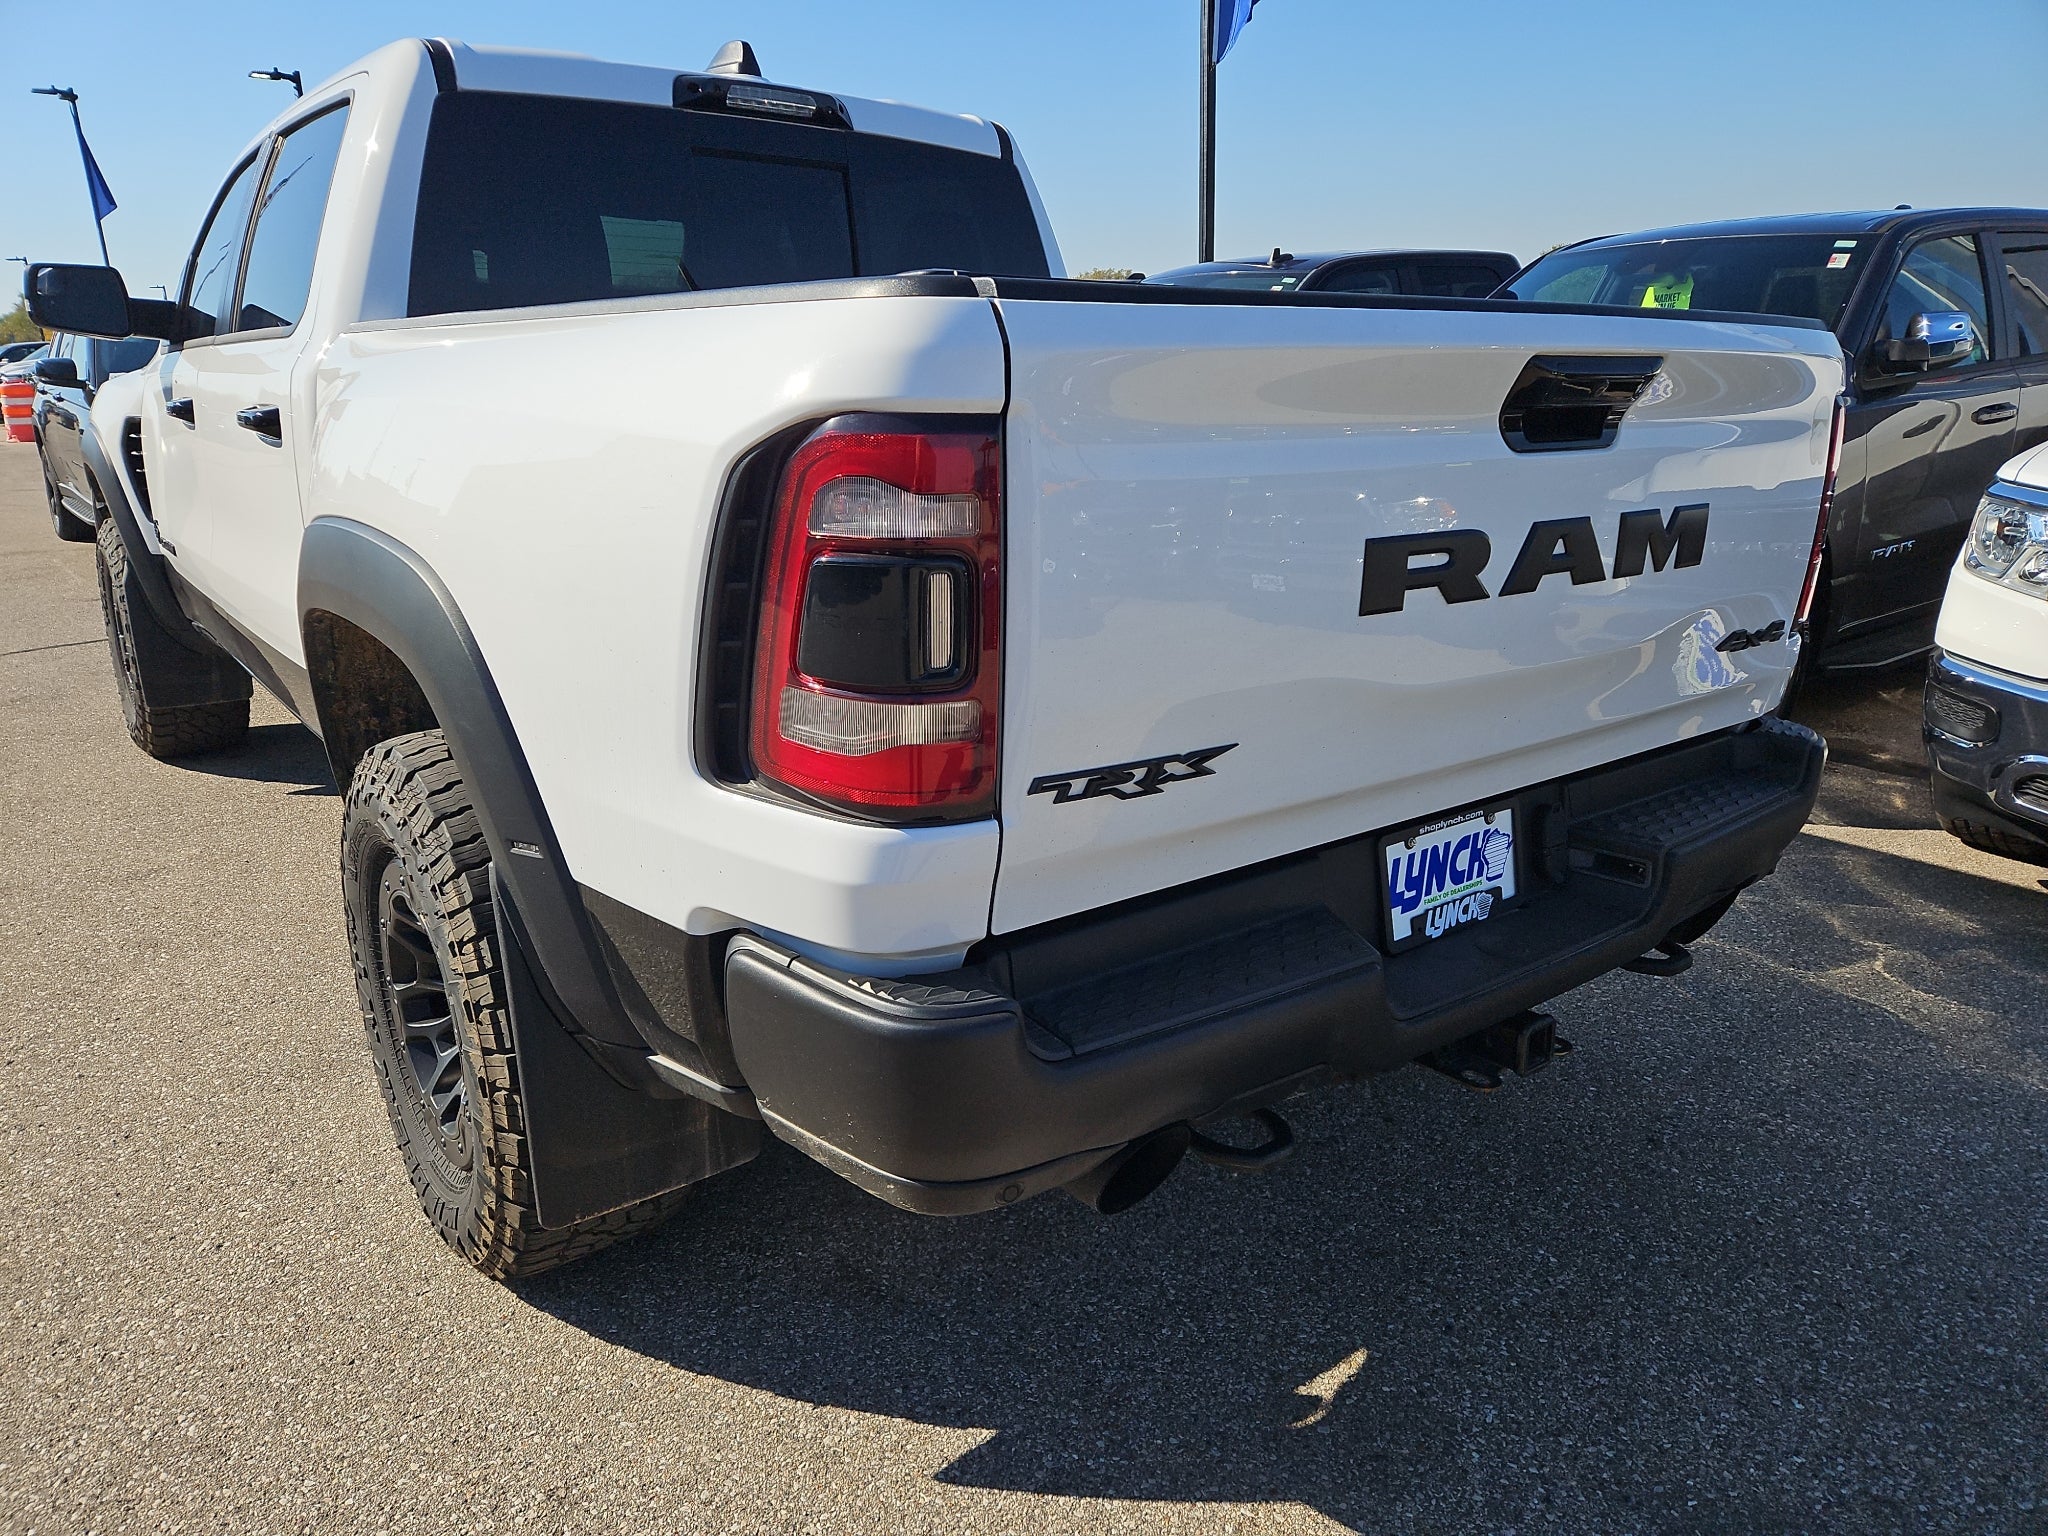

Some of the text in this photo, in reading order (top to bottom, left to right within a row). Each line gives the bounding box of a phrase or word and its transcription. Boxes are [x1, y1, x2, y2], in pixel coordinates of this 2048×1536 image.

[1655, 292, 1681, 303] MARKET
[1358, 502, 1710, 617] RAM
[1027, 742, 1240, 804] TRX
[1419, 810, 1484, 835] shoplynch.com
[1389, 828, 1492, 914] LYNCH
[1423, 879, 1483, 905] FAMILY OF DEALERSHIPS
[1425, 893, 1480, 938] LYNCH
